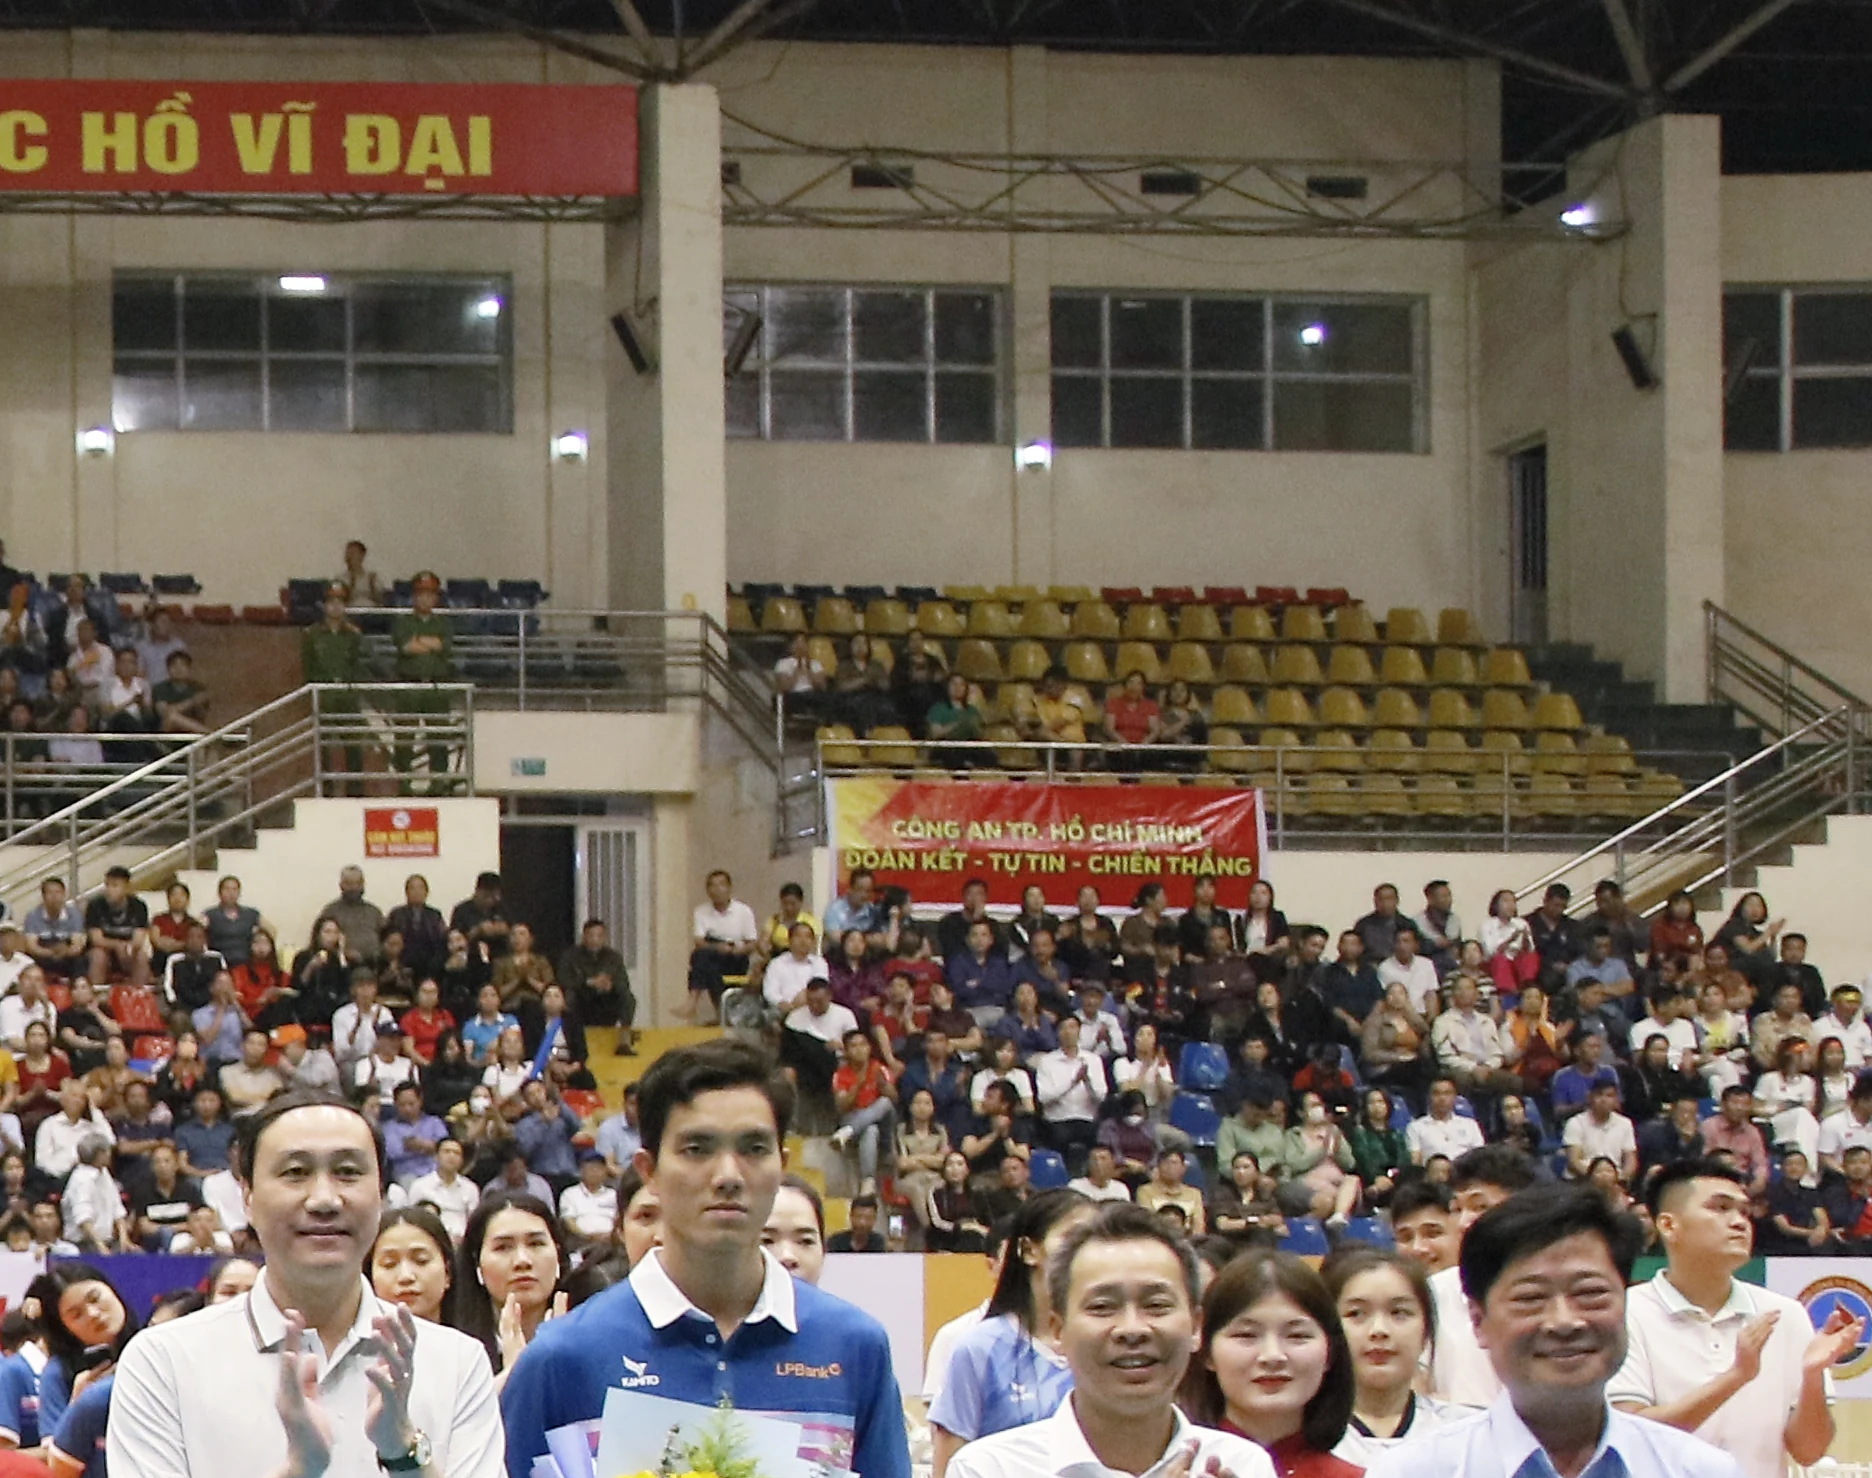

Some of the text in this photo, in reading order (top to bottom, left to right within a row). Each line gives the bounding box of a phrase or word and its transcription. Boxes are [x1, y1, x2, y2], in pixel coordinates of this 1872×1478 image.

[81, 91, 200, 175] HỒ
[230, 101, 316, 175] VĨ
[342, 113, 492, 191] ĐẠI
[892, 813, 1203, 844] CÔNG AN TP. HỒ CHÍ MINH
[844, 847, 917, 870] ĐOÀN
[922, 846, 968, 870] KẾT
[988, 851, 1022, 878] TỰ
[1028, 853, 1067, 873] TIN
[1088, 847, 1162, 875] CHIẾN
[1166, 849, 1252, 876] THẮNG
[776, 1362, 830, 1380] LPBank
